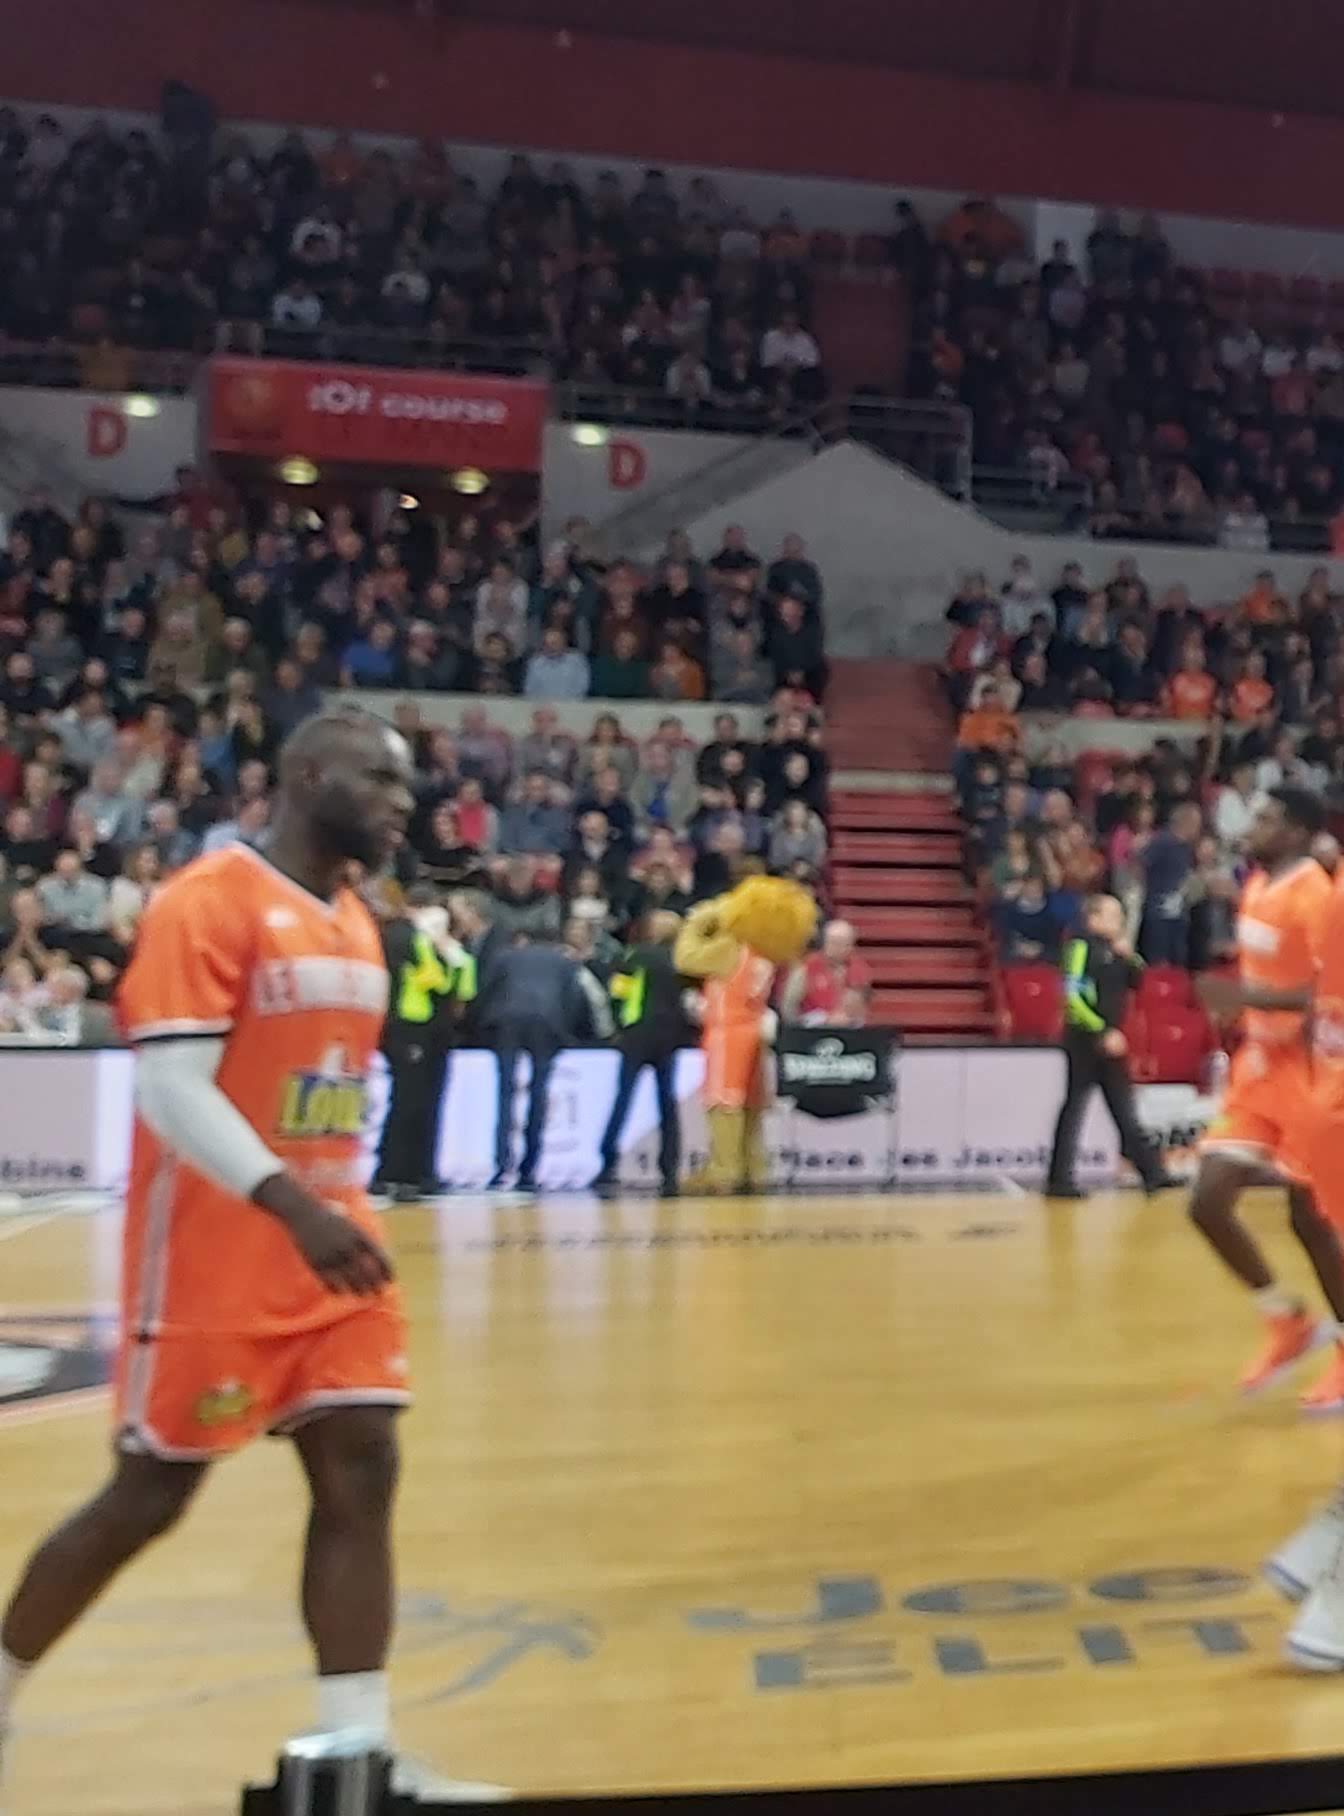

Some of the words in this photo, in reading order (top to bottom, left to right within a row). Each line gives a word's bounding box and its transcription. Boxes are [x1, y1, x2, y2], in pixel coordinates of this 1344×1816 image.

[88, 408, 128, 457] D
[381, 393, 508, 426] course
[608, 440, 646, 489] D
